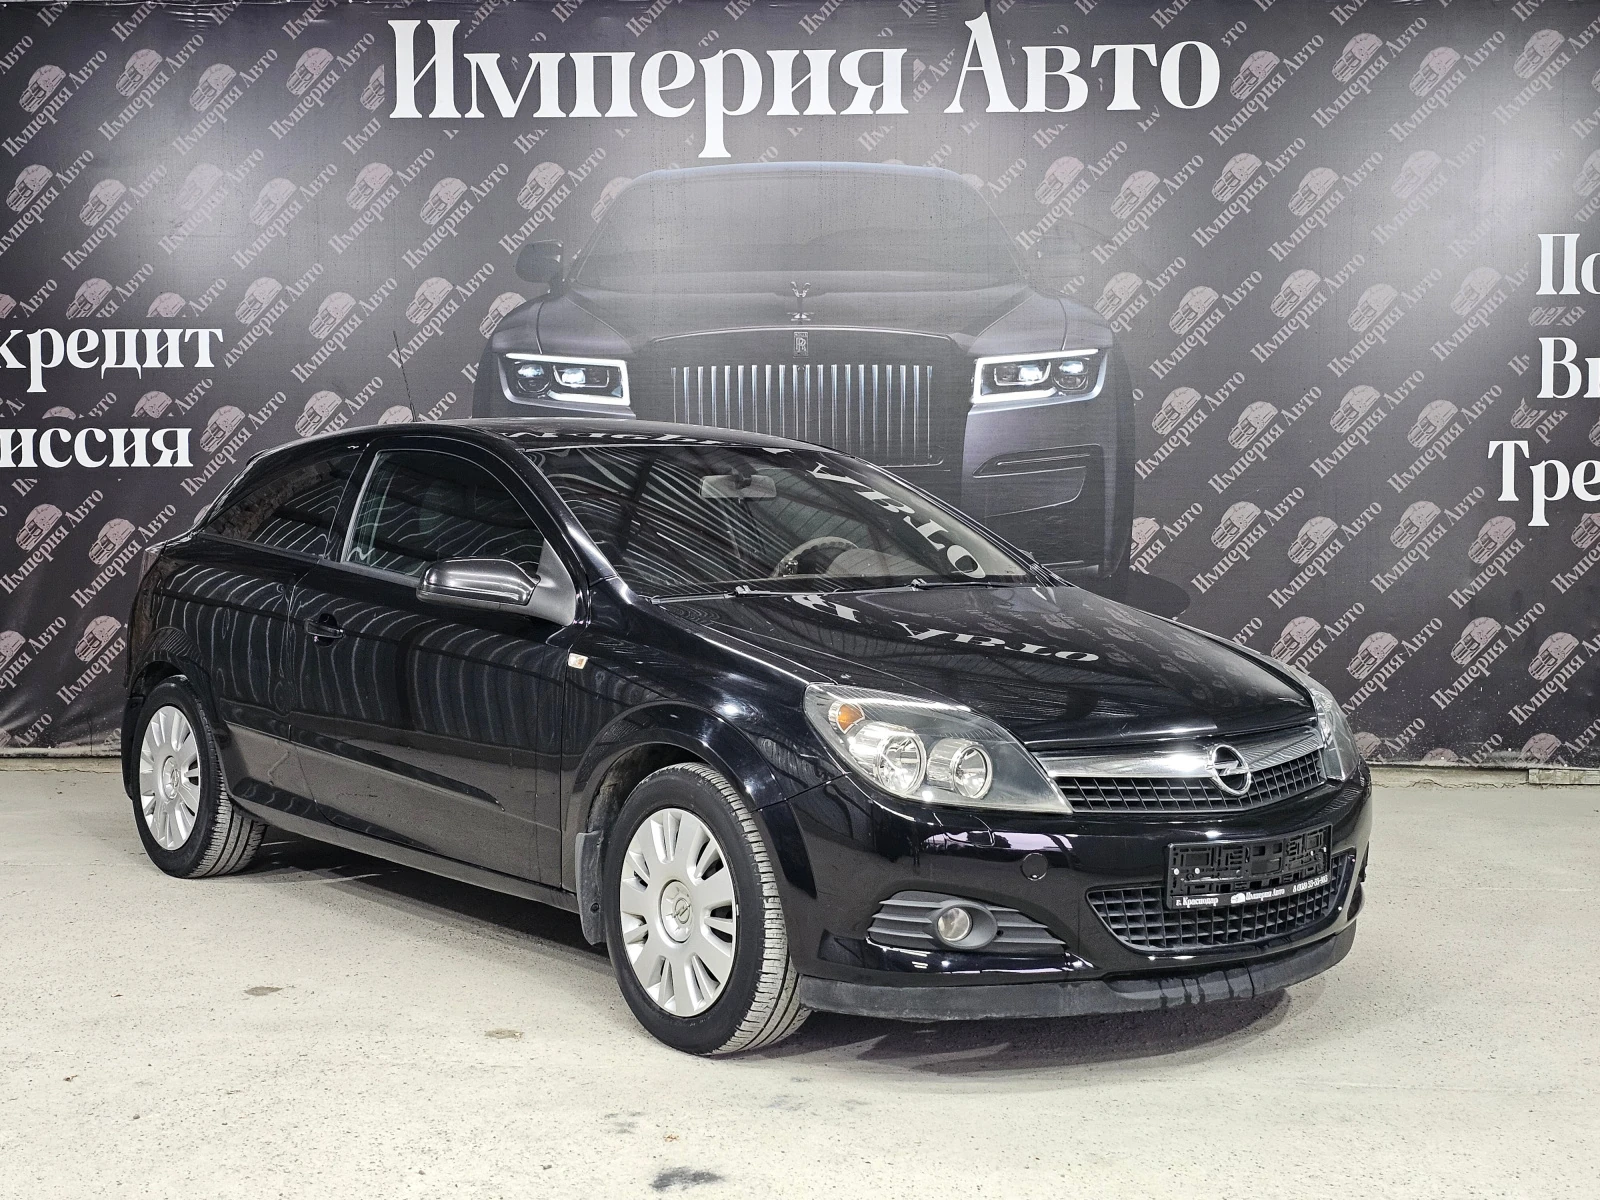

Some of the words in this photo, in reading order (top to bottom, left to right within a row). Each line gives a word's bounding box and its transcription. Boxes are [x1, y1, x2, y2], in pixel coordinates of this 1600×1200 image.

[1, 92, 73, 158] Империя
[68, 50, 107, 89] Авто
[98, 76, 170, 142] Империя
[165, 34, 204, 76] Авто
[172, 91, 244, 157] Империя
[239, 49, 278, 91] Авто
[269, 77, 341, 141] Империя
[336, 33, 375, 75] Авто
[388, 19, 908, 158] Империя
[943, 11, 1221, 114] Авто
[1208, 73, 1287, 147] Империя
[1283, 34, 1325, 76] Авто
[1314, 64, 1389, 131] Империя
[1386, 16, 1427, 57] Авто
[1387, 69, 1468, 143] Империя
[1464, 30, 1506, 72] Авто
[1491, 51, 1571, 126] Империя
[1568, 15, 1600, 55] Авт
[56, 149, 95, 190] Авто
[62, 209, 133, 272] Империя
[127, 164, 168, 204] Авто
[233, 208, 304, 272] Империя
[299, 162, 339, 204] Авто
[329, 192, 401, 256] Империя
[396, 148, 435, 190] Авто
[403, 207, 475, 271] Империя
[469, 162, 509, 203] Авто
[500, 192, 572, 256] Империя
[567, 147, 606, 189] Авто
[986, 157, 1027, 198] Авто
[1017, 187, 1090, 251] Империя
[1087, 139, 1129, 182] Авто
[1089, 193, 1167, 265] Империя
[1163, 154, 1205, 196] Авто
[1192, 182, 1268, 249] Империя
[1264, 136, 1306, 178] Авто
[1267, 190, 1345, 262] Империя
[1342, 150, 1384, 193] Авто
[20, 278, 59, 318] Авто
[113, 263, 155, 302] Авто
[189, 277, 228, 317] Авто
[283, 262, 324, 302] Авто
[290, 321, 362, 384] Империя
[358, 277, 399, 318] Авто
[388, 307, 459, 370] Империя
[453, 262, 495, 303] Авто
[1110, 292, 1149, 333] ерия
[1145, 255, 1187, 297] Авто
[1148, 309, 1226, 380] Империя
[1221, 269, 1264, 312] Авто
[1249, 292, 1327, 364] Империя
[1324, 252, 1366, 295] Авто
[1326, 306, 1405, 378] Империя
[1401, 267, 1443, 309] Авто
[1430, 297, 1508, 364] Империя
[173, 376, 214, 416] Авто
[180, 434, 252, 497] Империя
[246, 391, 288, 430] Авто
[343, 376, 385, 415] Авто
[1134, 417, 1207, 481] Империя
[1204, 371, 1246, 415] Авто
[1207, 423, 1286, 495] Империя
[1281, 385, 1323, 427] Авто
[1309, 407, 1387, 479] Империя
[1383, 369, 1425, 411] Авто
[1386, 422, 1465, 494] Империя
[1461, 384, 1503, 425] Авто
[0, 533, 69, 596] Империя
[63, 489, 105, 528] Авто
[71, 547, 142, 610] Империя
[136, 503, 178, 544] Авто
[1162, 501, 1204, 543] Авто
[1190, 523, 1268, 595] Империя
[1263, 485, 1305, 527] Авто
[1267, 538, 1346, 610] Империя
[1341, 501, 1383, 542] Авто
[1369, 523, 1448, 595] Империя
[1443, 484, 1486, 527] Авто
[1447, 538, 1526, 610] Империя
[26, 616, 68, 655] Авто
[56, 635, 127, 706] Империя
[1323, 601, 1366, 642] Авто
[1401, 616, 1444, 658] Авто
[1430, 639, 1509, 711] Империя
[1504, 601, 1547, 643] Авто
[13, 713, 53, 748] Авто
[1383, 717, 1426, 758] Авто
[1507, 654, 1586, 726] Империя
